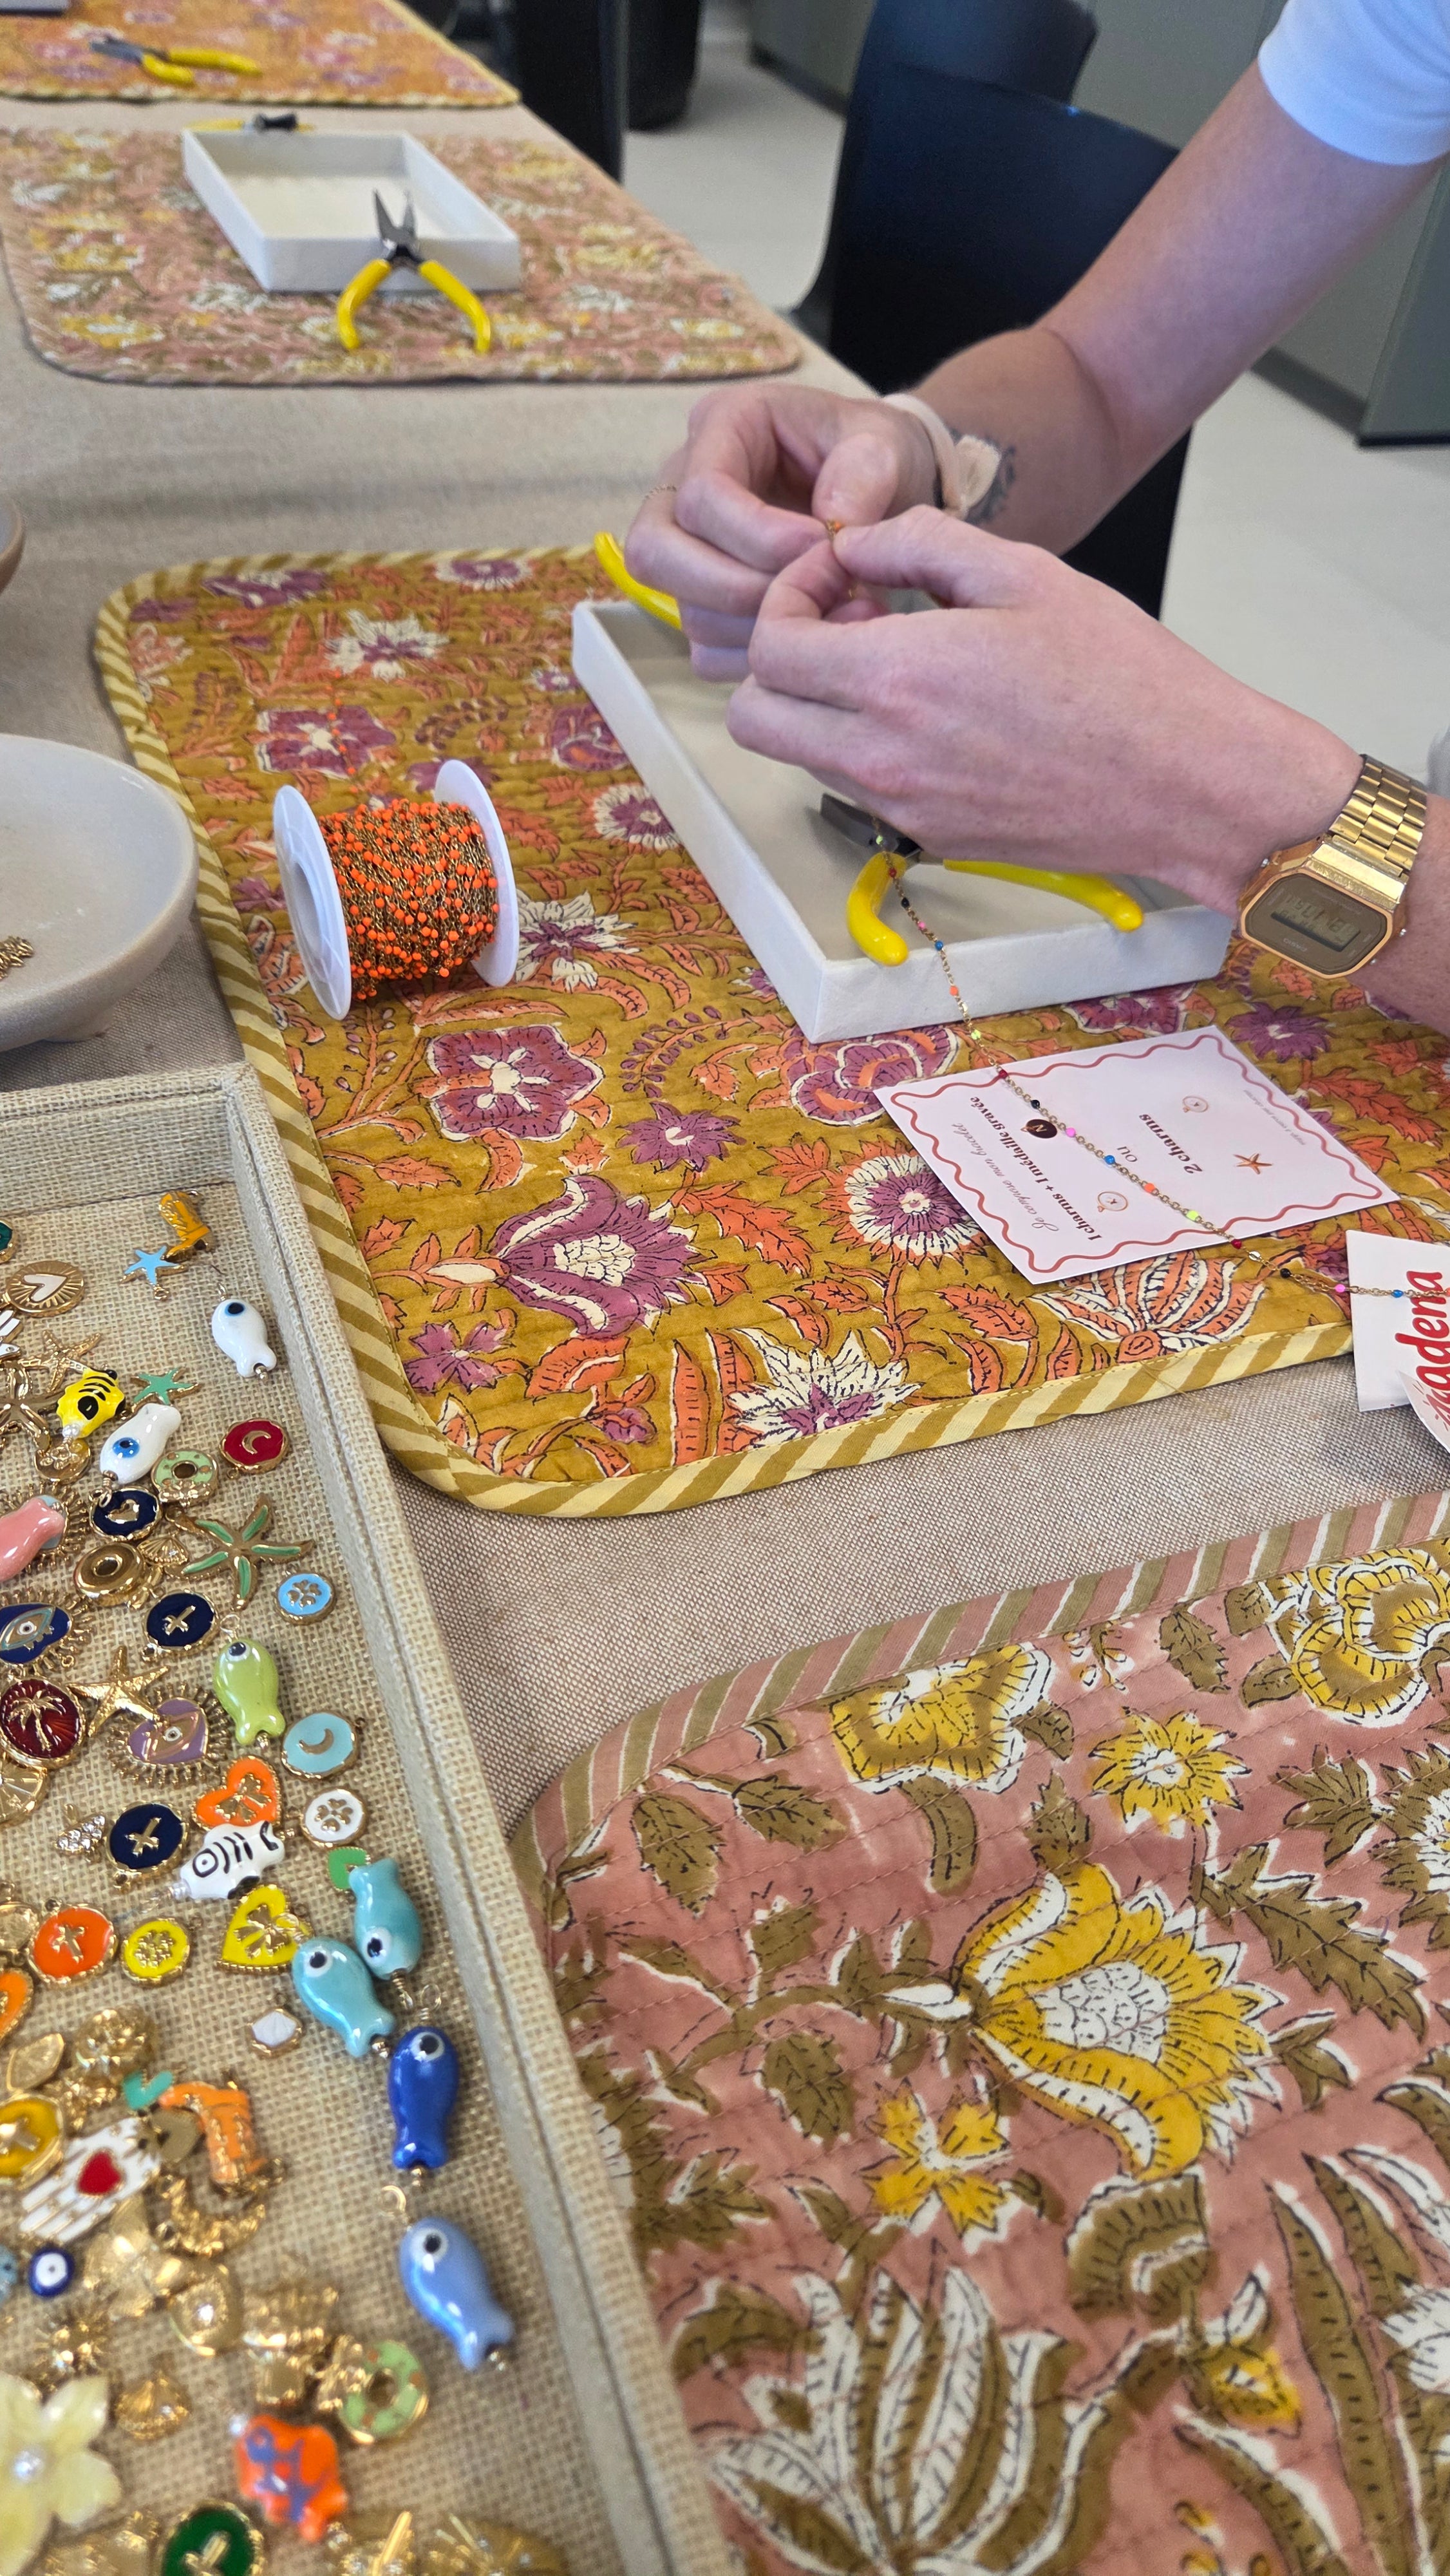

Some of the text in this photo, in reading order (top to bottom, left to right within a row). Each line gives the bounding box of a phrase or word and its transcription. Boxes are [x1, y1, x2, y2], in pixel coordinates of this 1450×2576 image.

[970, 1097, 1005, 1130] gravée
[999, 1132, 1043, 1176] médaille
[1139, 1114, 1203, 1173] 2 charms
[952, 1123, 1059, 1231] Je compose mon bracelet
[1053, 1194, 1095, 1233] charms
[1395, 1271, 1450, 1391] adena
